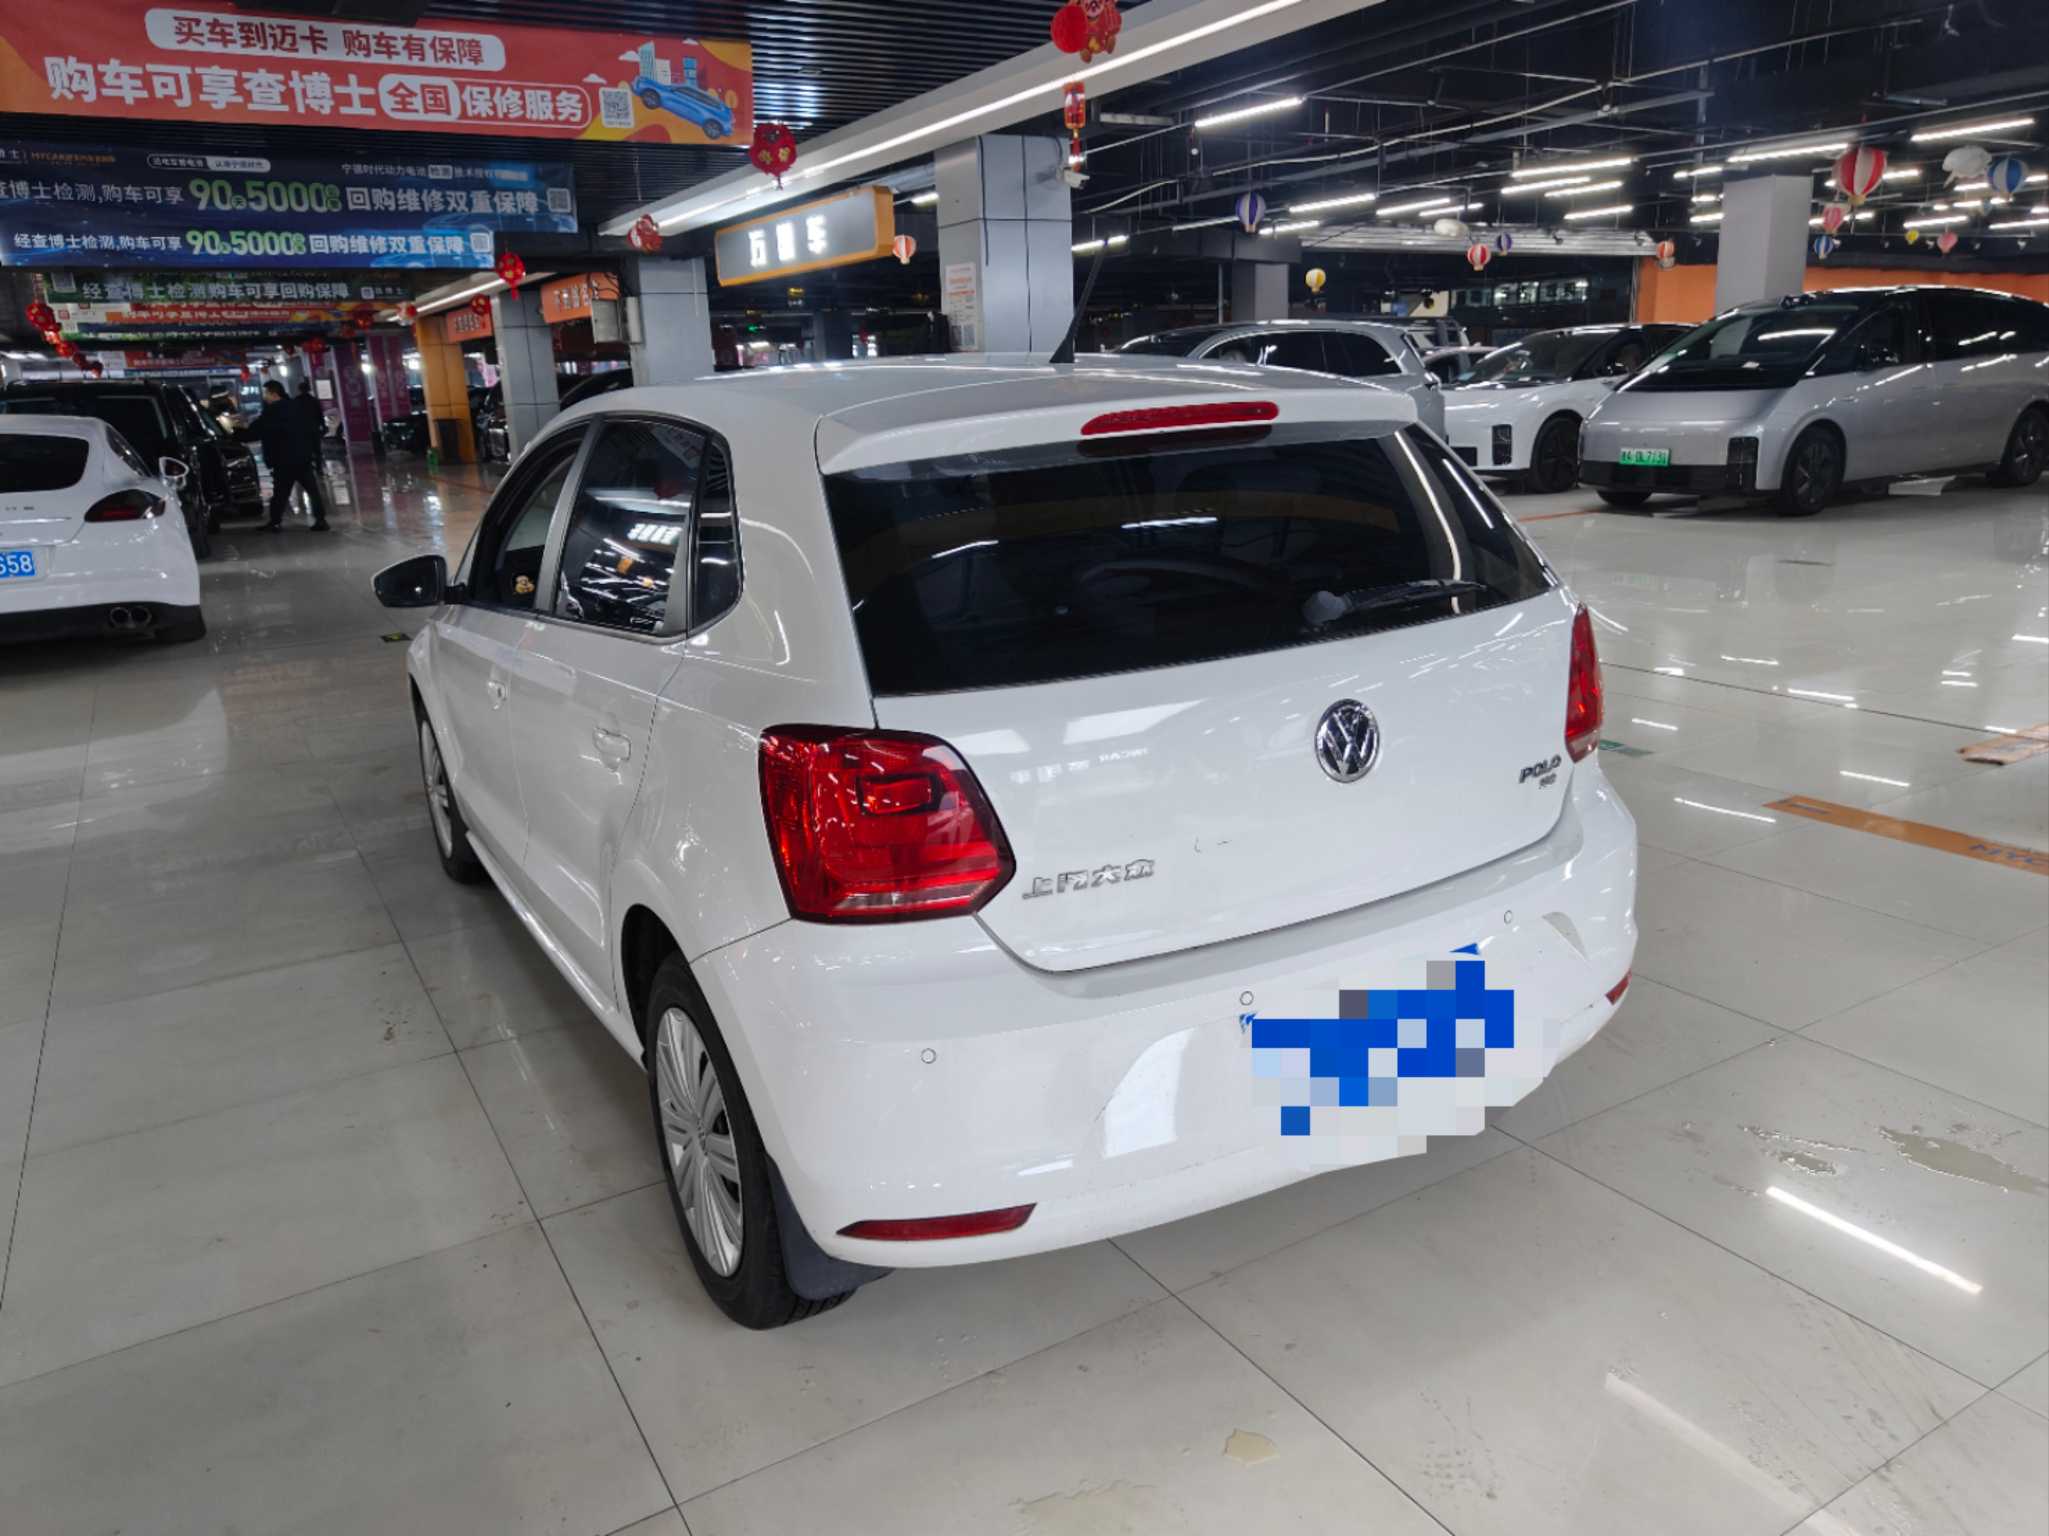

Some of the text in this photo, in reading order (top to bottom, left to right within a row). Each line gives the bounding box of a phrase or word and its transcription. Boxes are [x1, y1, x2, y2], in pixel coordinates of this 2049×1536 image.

[173, 15, 484, 66] 买车到迈卡 购车有保障
[1519, 753, 1562, 784] POLO
